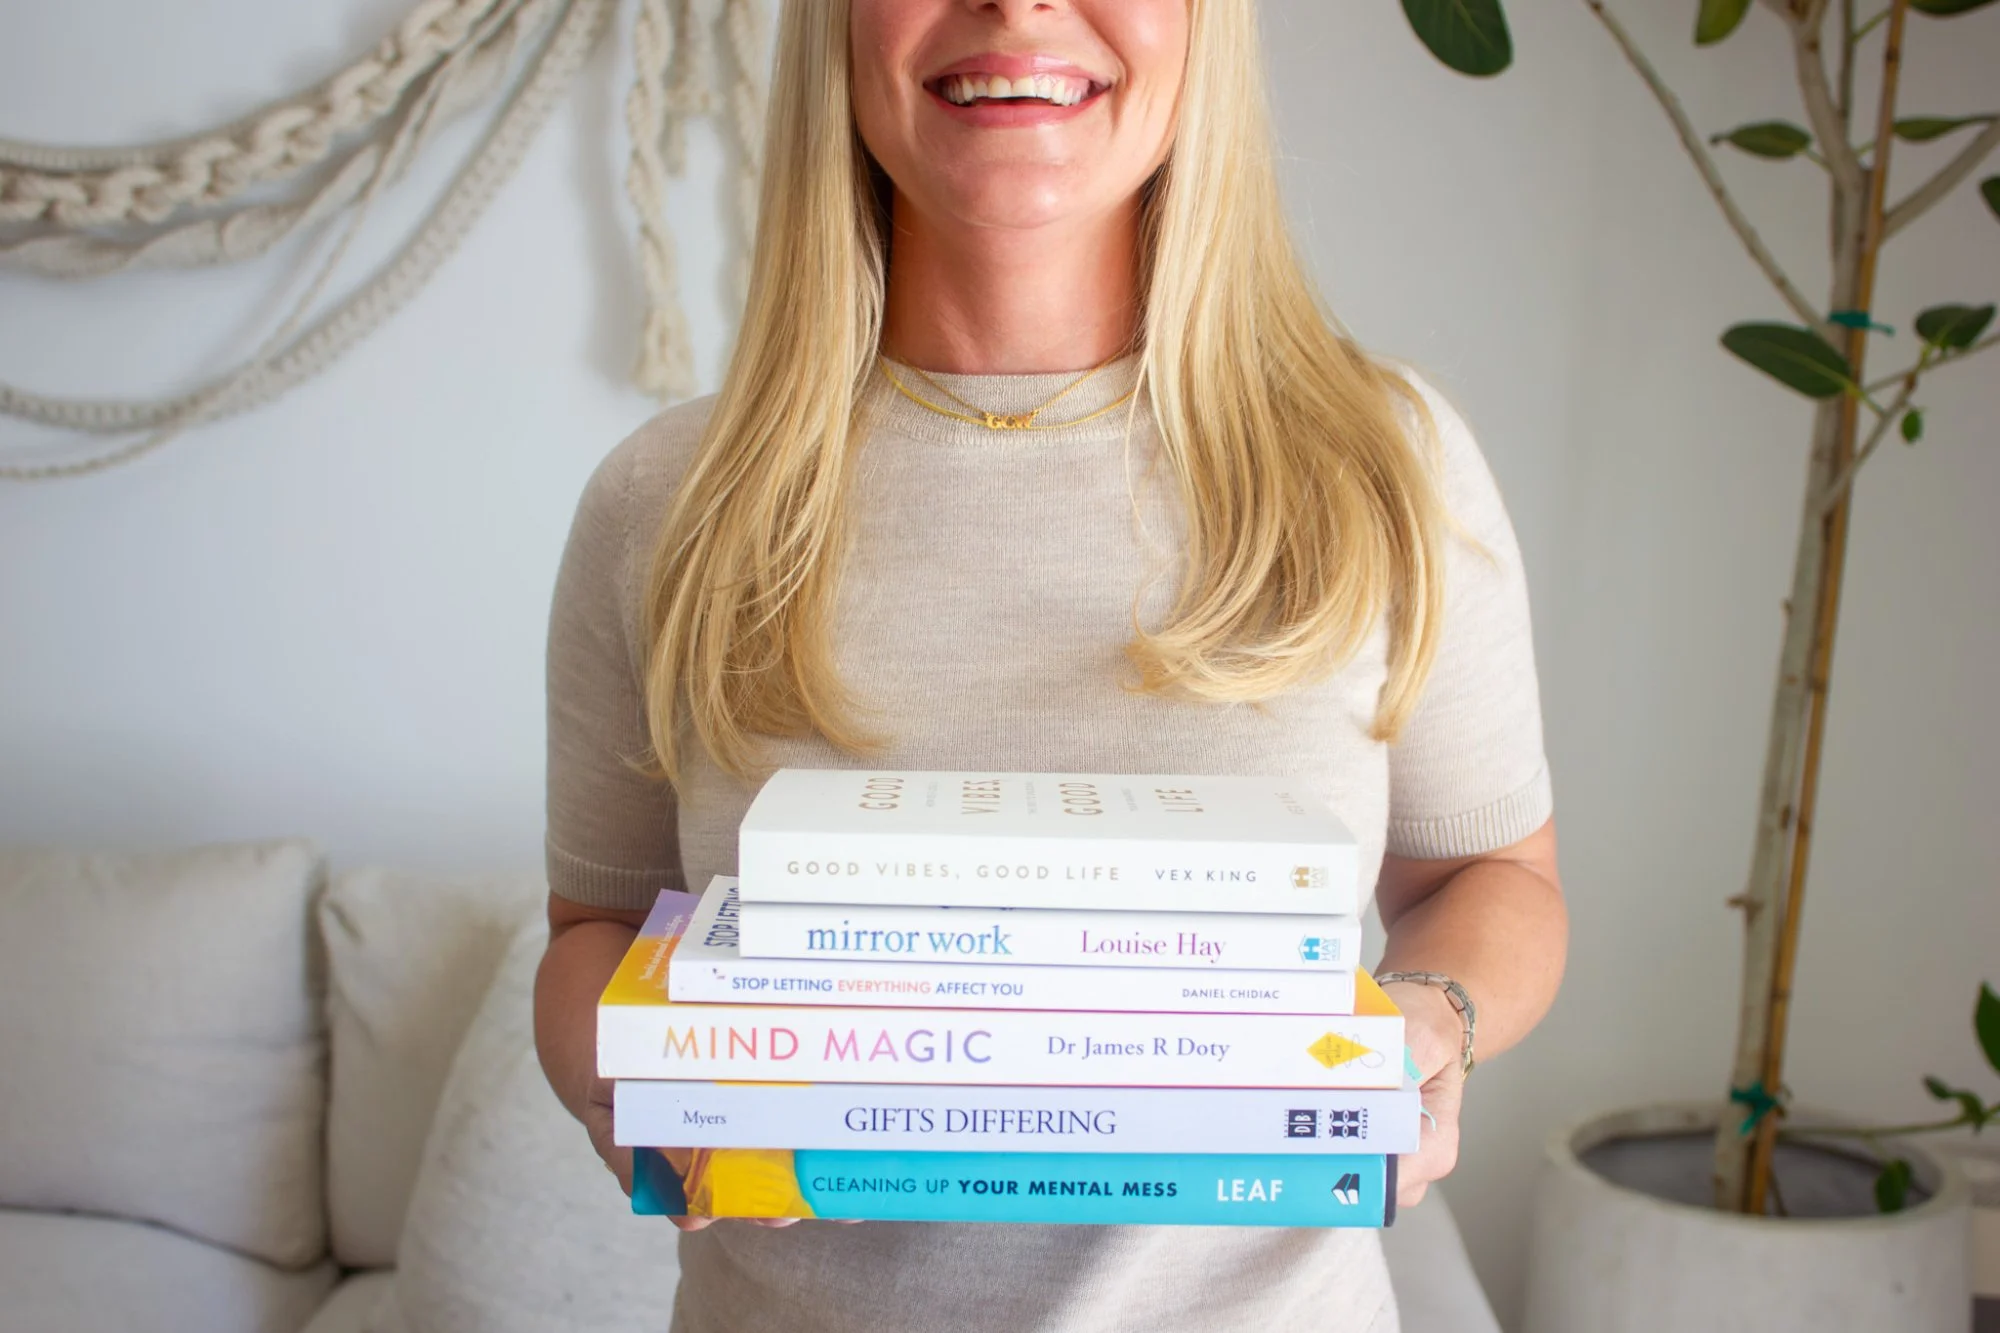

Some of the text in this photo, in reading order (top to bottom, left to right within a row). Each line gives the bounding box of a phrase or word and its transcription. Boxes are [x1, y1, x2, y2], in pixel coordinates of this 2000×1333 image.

[859, 778, 904, 809] GOOD
[962, 780, 1000, 814] VIBES
[1059, 783, 1103, 815] GOOD
[1155, 789, 1203, 812] LIFE
[787, 861, 1118, 881] GOOD VIBES, GOOD LIFE
[1155, 869, 1256, 882] VEX KING
[704, 887, 740, 947] STOP LETT
[808, 920, 1012, 955] mirror work
[1081, 930, 1226, 963] Louise Hay
[732, 977, 1023, 996] STOP LETTING EVERYTHING AFFECT YOU
[1182, 989, 1279, 999] DANIEL CHIDIAC
[664, 1026, 992, 1064] MIND MAGIC
[1048, 1036, 1230, 1062] Dr James R Doty
[683, 1110, 726, 1128] Myers
[845, 1108, 1116, 1134] GIFTS DIFFERING
[813, 1177, 1177, 1197] CLEANING UP YOUR MENTAL MESS
[1217, 1179, 1283, 1201] LEAF
